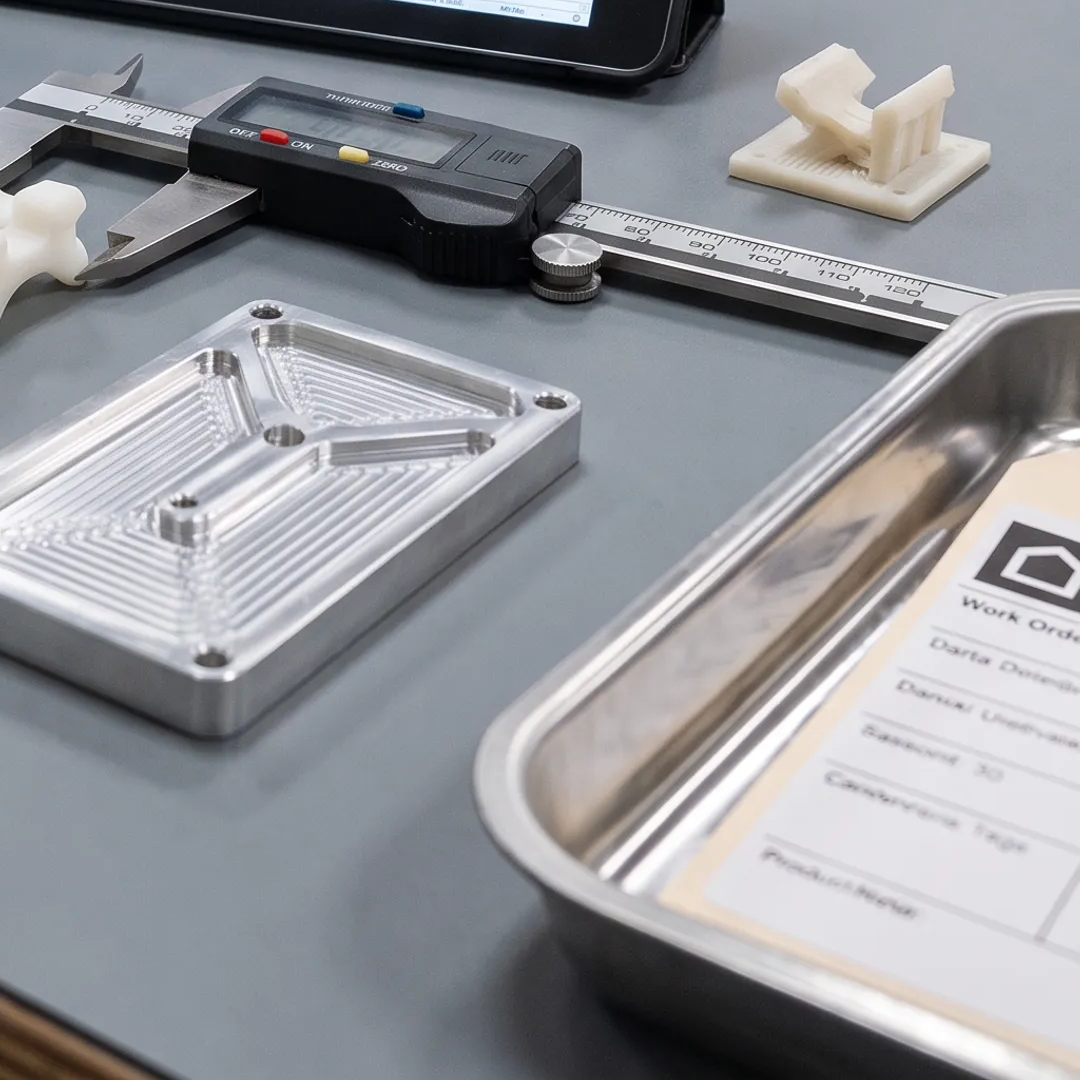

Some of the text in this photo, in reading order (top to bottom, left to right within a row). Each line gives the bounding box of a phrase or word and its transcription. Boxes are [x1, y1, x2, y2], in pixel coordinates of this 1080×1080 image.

[291, 140, 315, 151] ON
[371, 160, 408, 172] ZERO
[624, 225, 650, 236] 80
[688, 240, 716, 252] 90
[748, 253, 783, 266] 100
[818, 269, 851, 282] 110
[884, 284, 921, 298] 120
[962, 595, 1021, 624] Work
